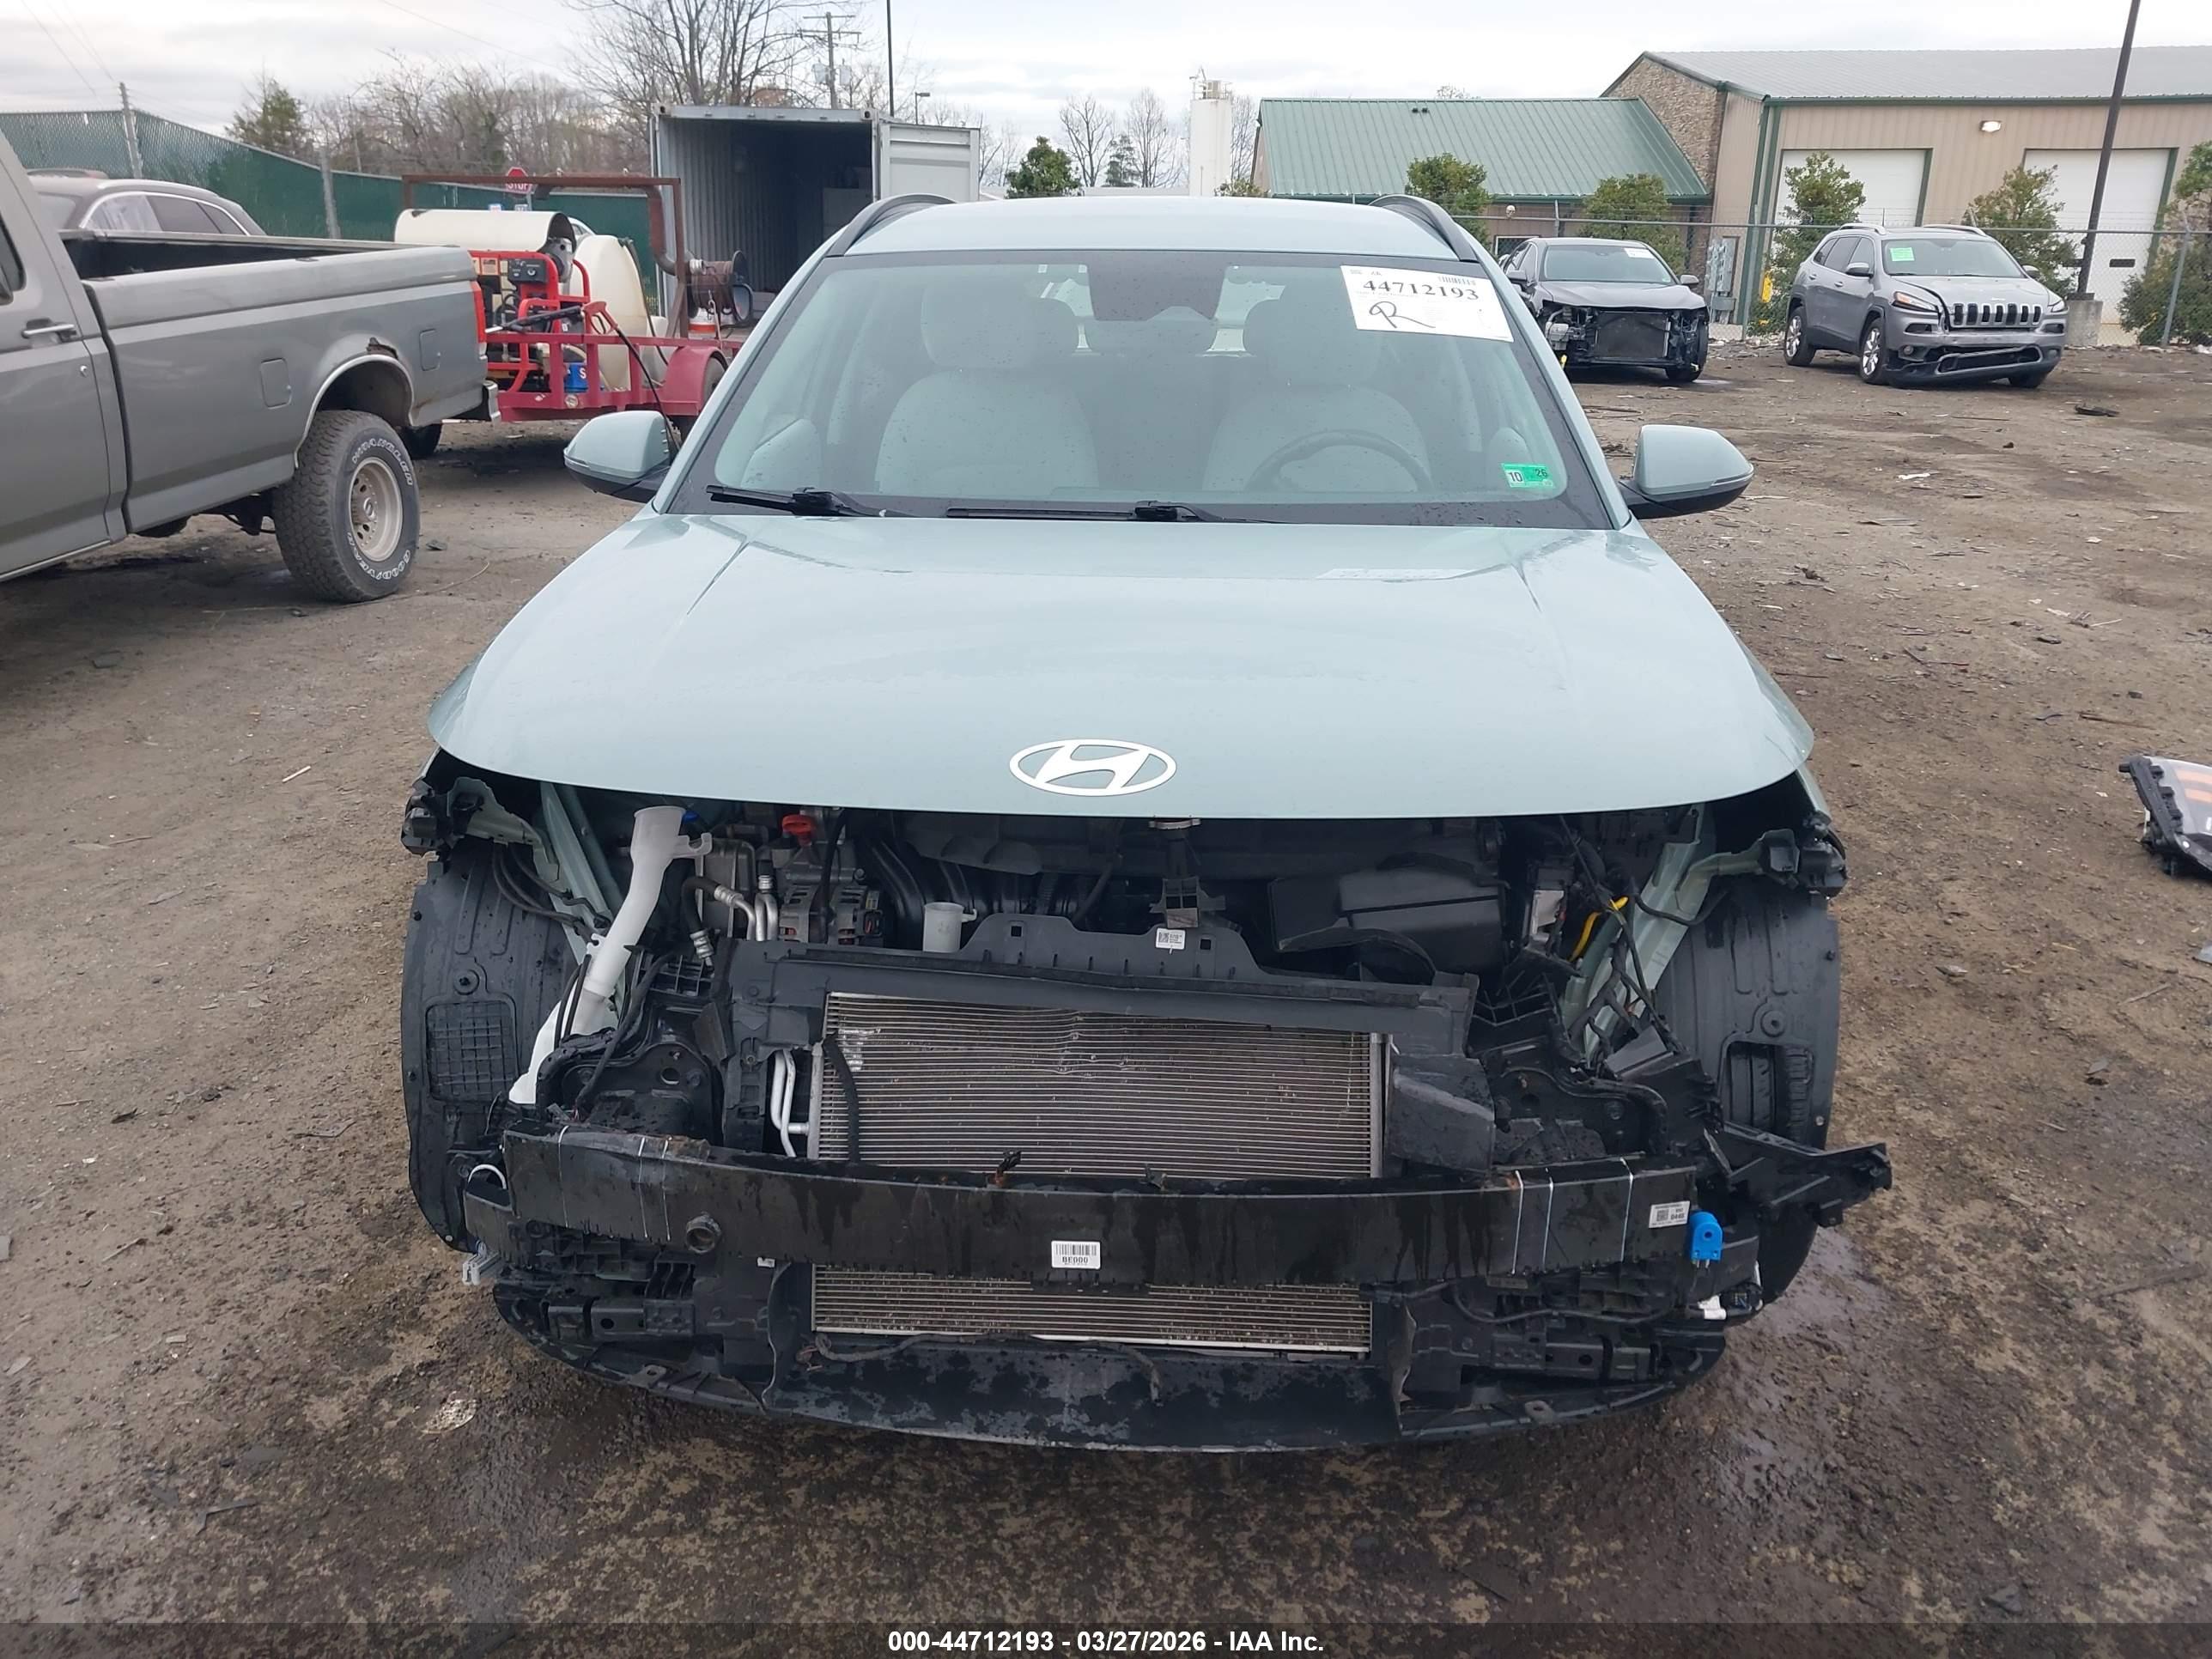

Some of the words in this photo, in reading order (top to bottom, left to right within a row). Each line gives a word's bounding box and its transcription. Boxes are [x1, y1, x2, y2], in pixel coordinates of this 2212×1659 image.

[1363, 280, 1480, 301] 44712193
[1508, 471, 1523, 483] 10
[347, 532, 410, 580] GOODYEAR
